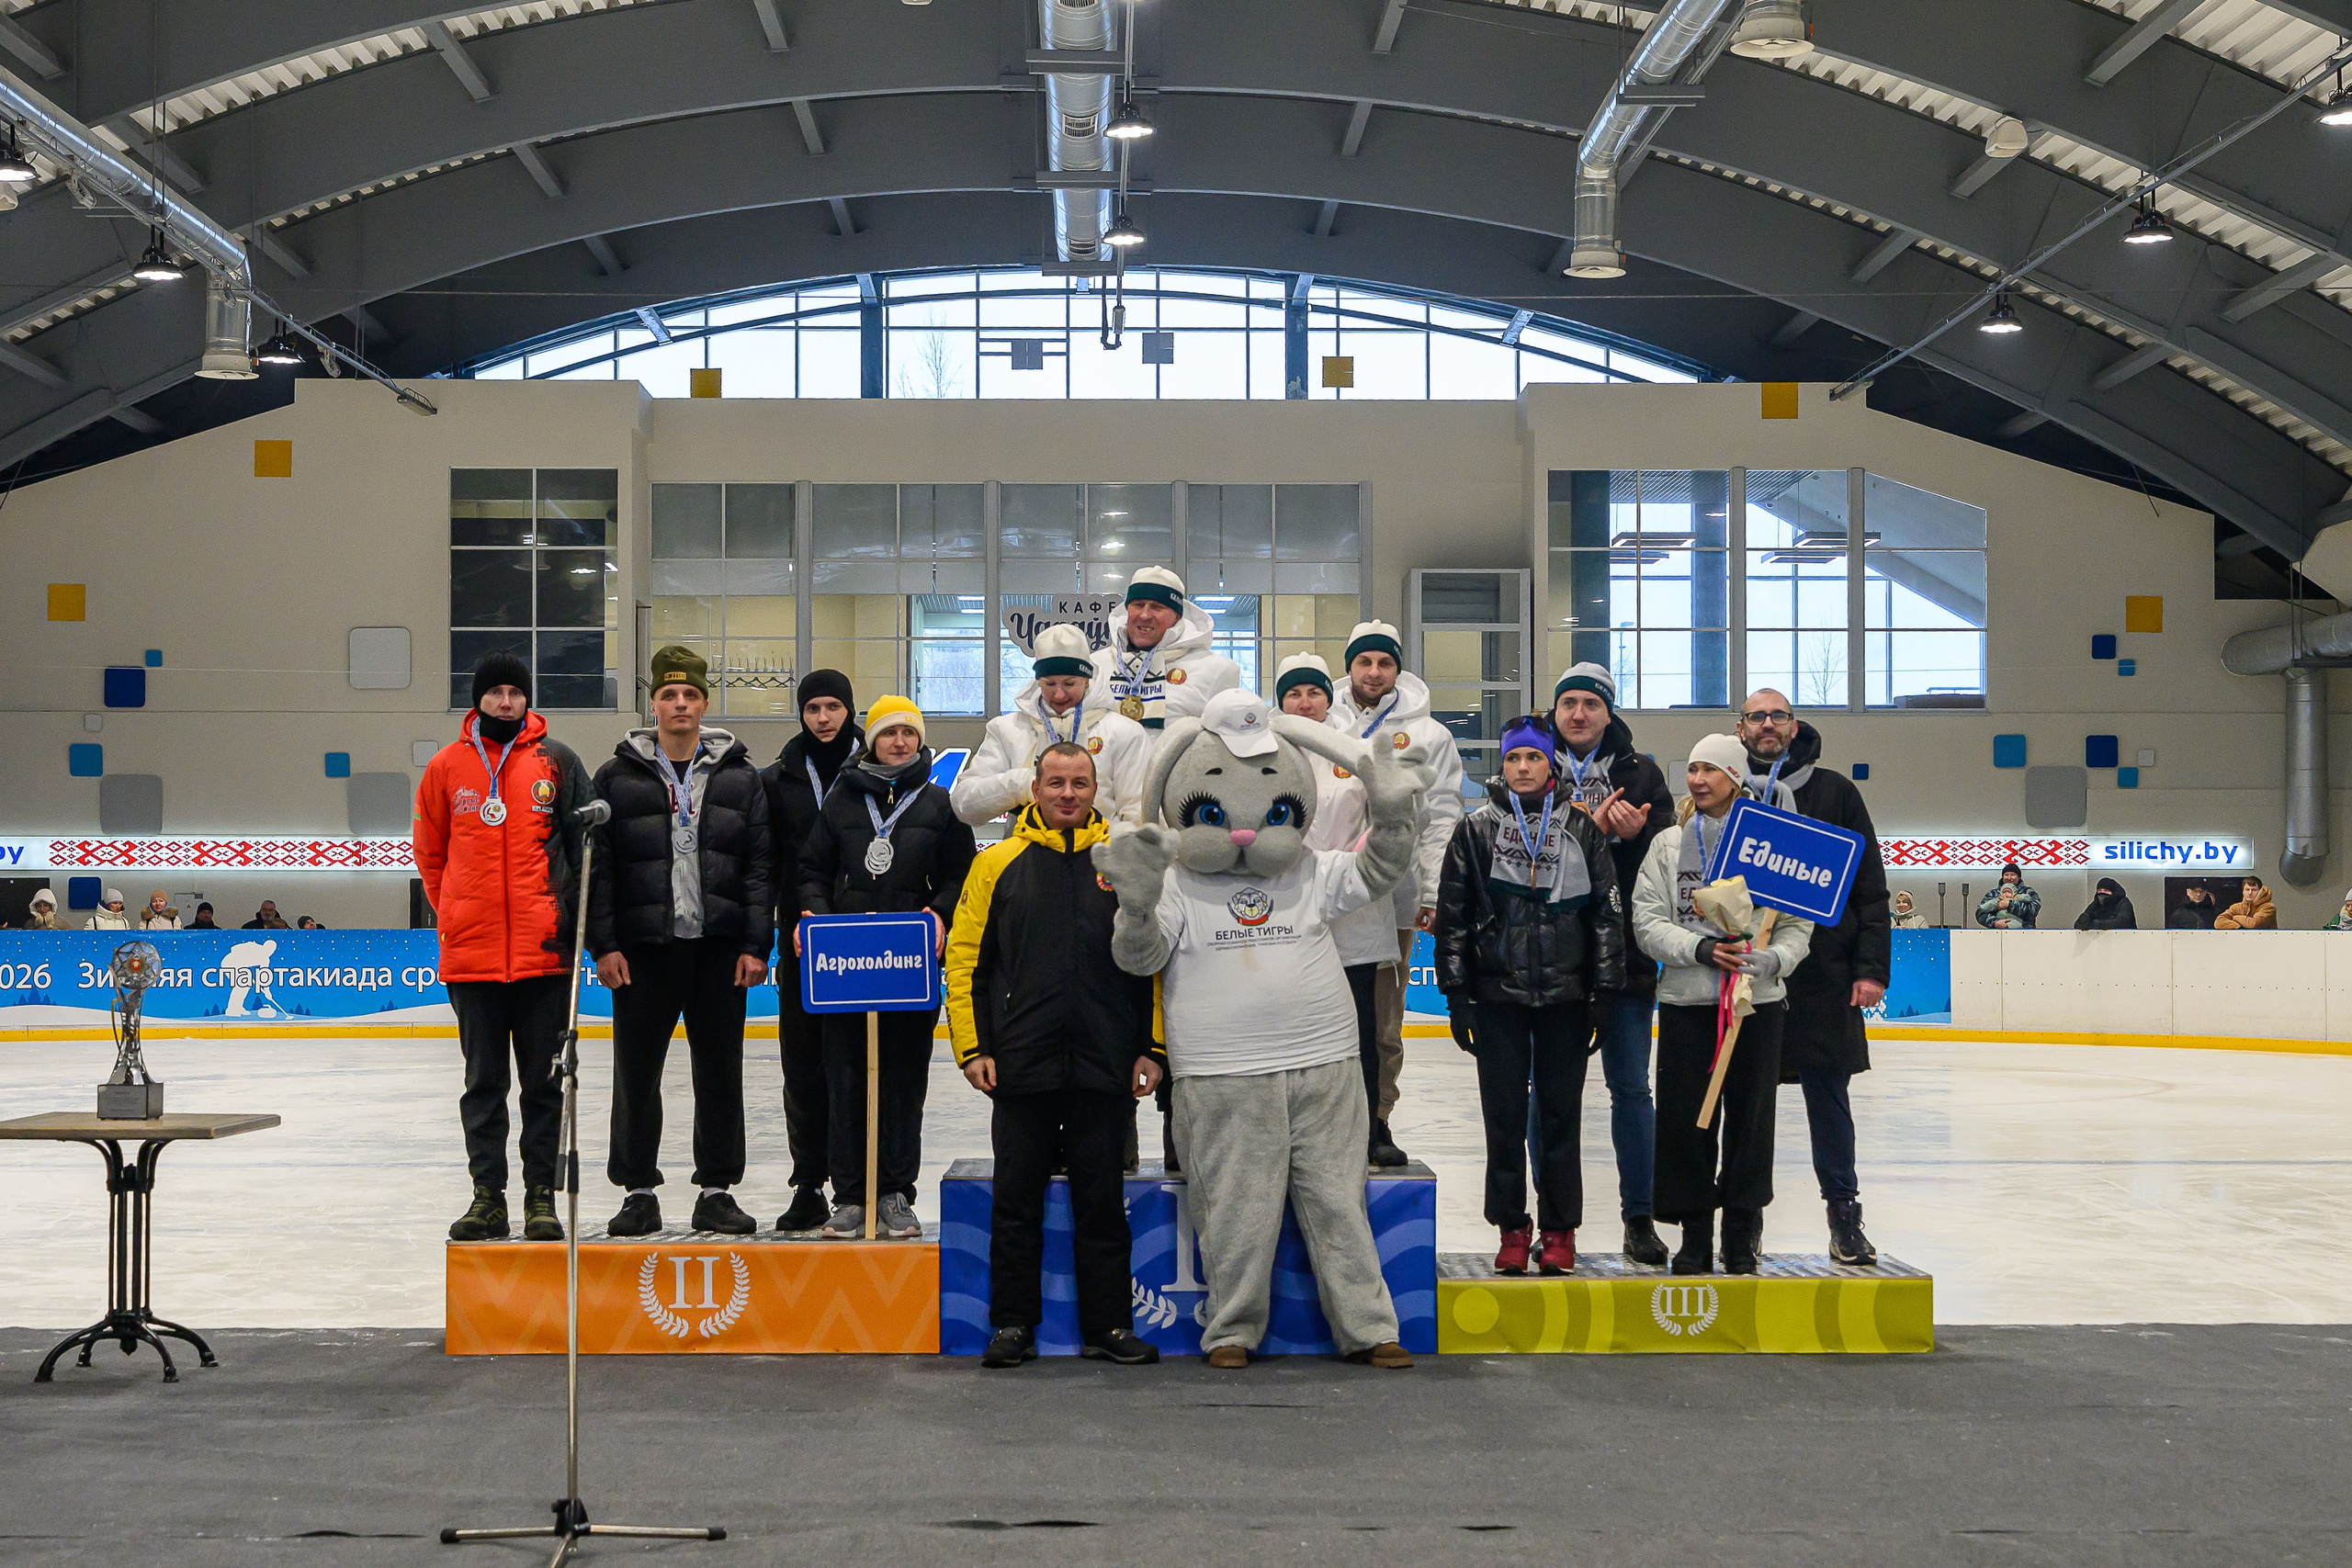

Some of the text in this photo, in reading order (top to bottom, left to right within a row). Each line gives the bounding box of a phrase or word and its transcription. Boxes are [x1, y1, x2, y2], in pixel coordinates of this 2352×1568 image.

[1140, 683, 1162, 695] ИГРЫ
[1738, 836, 1833, 888] Единые
[2105, 841, 2238, 863] silichy.by
[1216, 931, 1255, 941] БЕЛЫЕ
[1256, 925, 1294, 937] ТИГРЫ
[816, 950, 922, 976] Агрохолдинг
[201, 966, 393, 993] спартакиада
[668, 1257, 720, 1308] II
[1663, 1287, 1708, 1316] III
